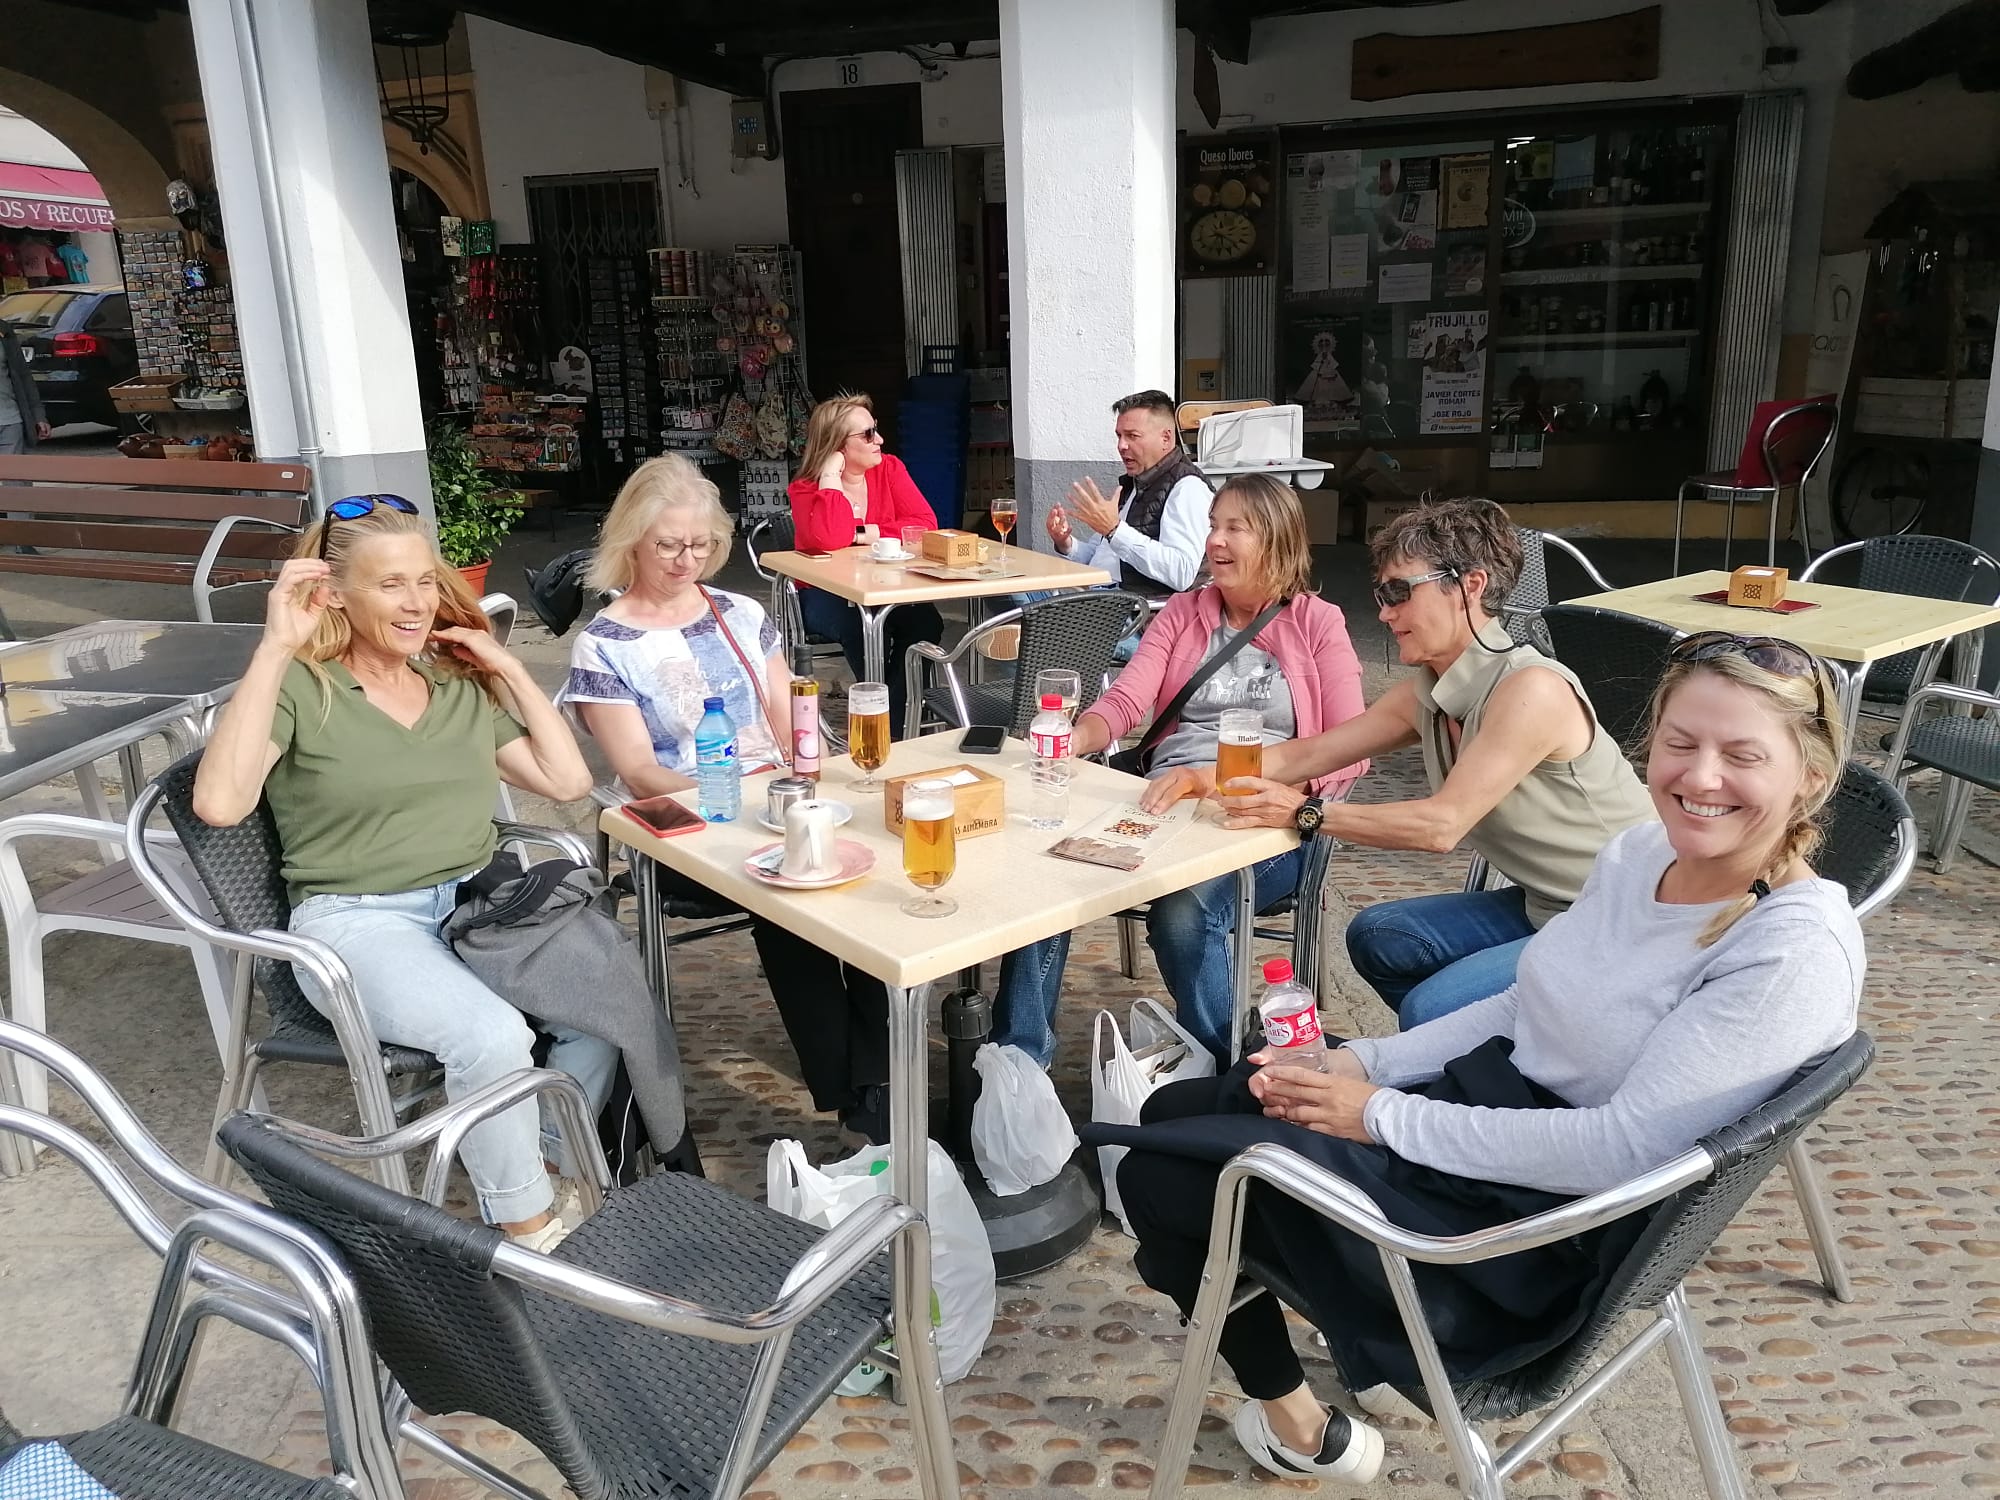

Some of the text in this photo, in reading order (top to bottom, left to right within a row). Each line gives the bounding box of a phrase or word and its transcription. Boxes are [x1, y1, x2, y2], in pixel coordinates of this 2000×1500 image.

[842, 63, 858, 85] 18
[1200, 147, 1255, 166] Queso Ibores
[28, 202, 42, 220] Y
[1428, 314, 1487, 328] TRUJILLO
